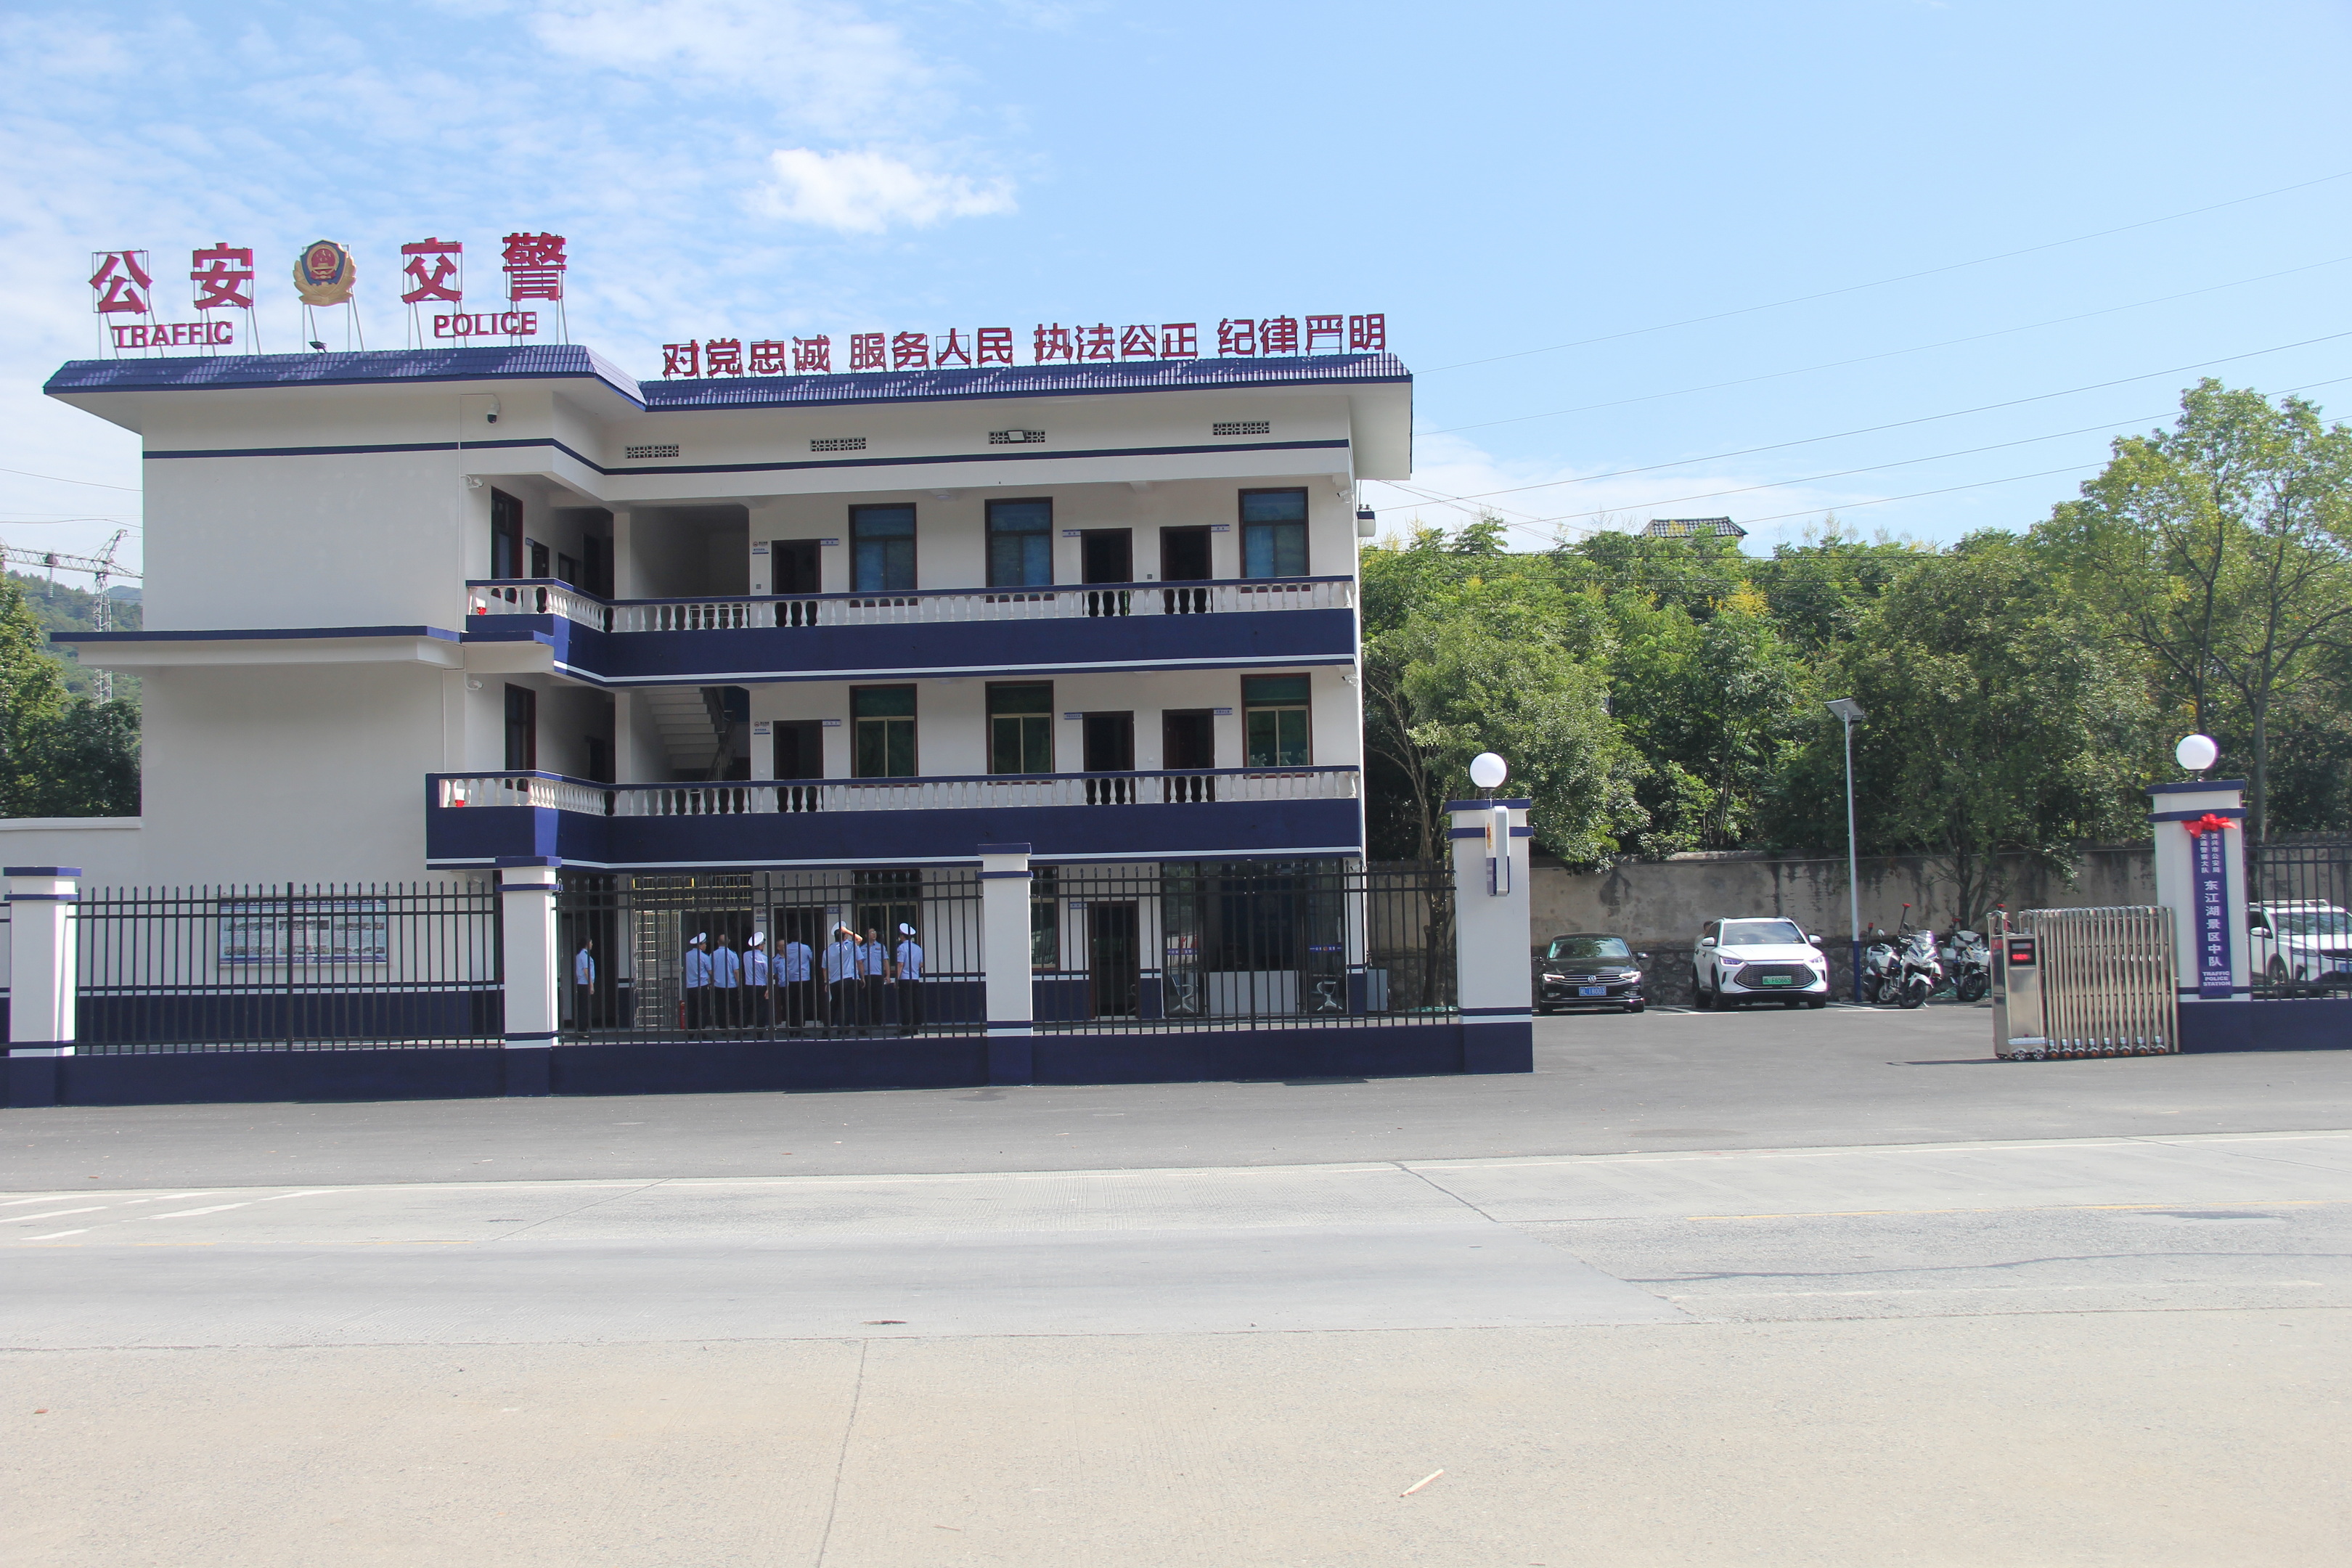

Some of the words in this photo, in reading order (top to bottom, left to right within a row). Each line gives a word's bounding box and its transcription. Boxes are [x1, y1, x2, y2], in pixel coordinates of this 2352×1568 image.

[89, 242, 254, 314] 公安
[401, 232, 567, 304] 交警
[113, 321, 233, 348] TRAFFIC
[434, 311, 537, 338] POLICE
[662, 334, 830, 377] 对党忠诚
[849, 327, 1013, 369] 服务人民
[1033, 322, 1199, 362] 执法公正
[1217, 313, 1387, 355] 纪律严明
[2203, 880, 2223, 967] 东江湖景区中队
